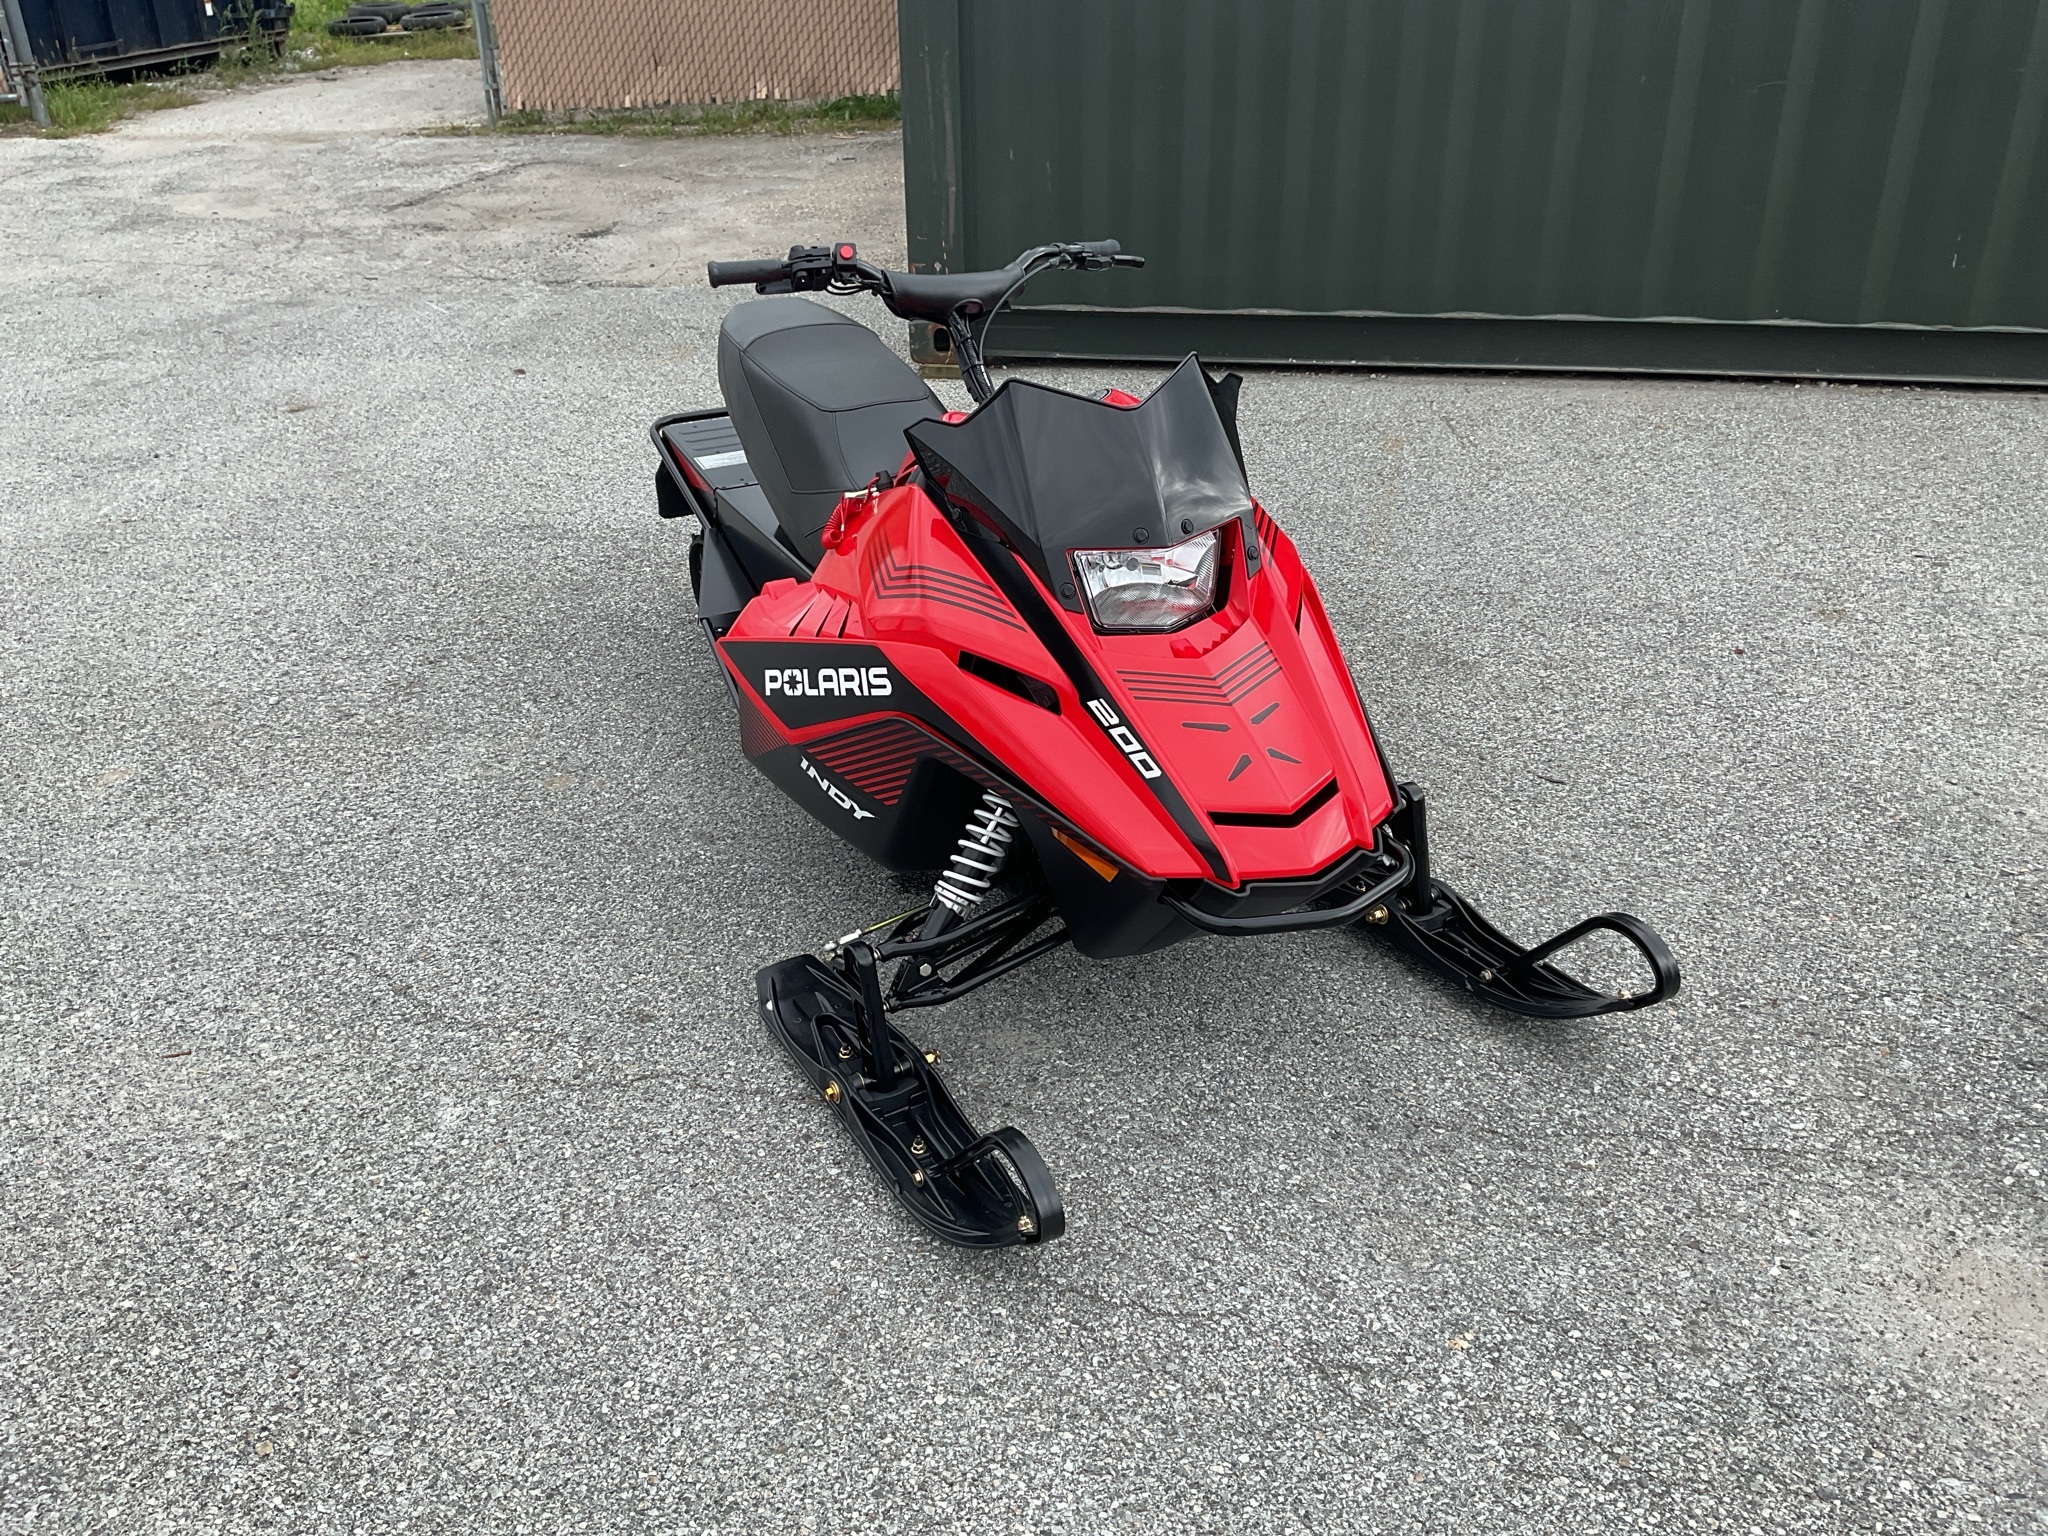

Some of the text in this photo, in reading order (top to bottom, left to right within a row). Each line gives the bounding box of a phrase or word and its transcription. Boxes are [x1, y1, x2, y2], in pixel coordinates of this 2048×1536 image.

[764, 667, 892, 696] POLARIS
[1087, 698, 1163, 779] 200
[799, 756, 877, 821] INDY
